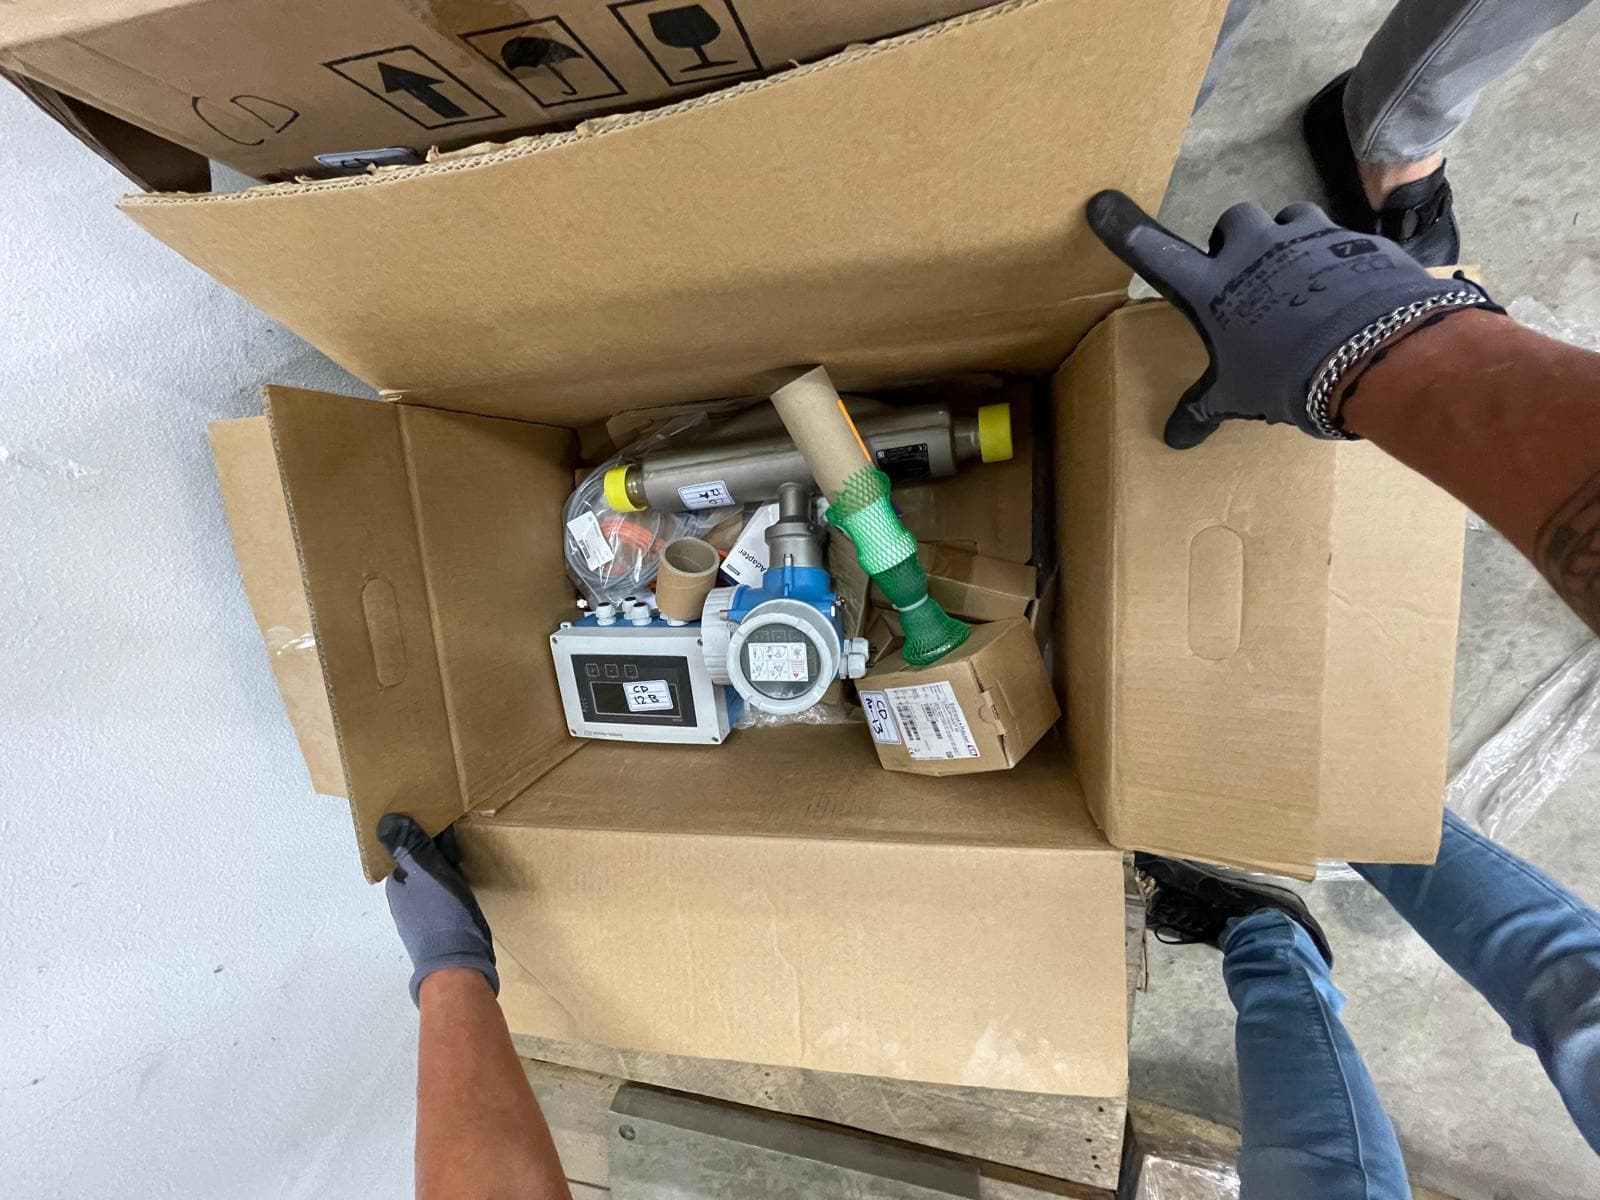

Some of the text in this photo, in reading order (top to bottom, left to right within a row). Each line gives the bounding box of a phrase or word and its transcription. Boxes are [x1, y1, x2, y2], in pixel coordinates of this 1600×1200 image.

[738, 548, 767, 573] Adapter
[632, 685, 649, 693] CD
[876, 700, 888, 720] CD
